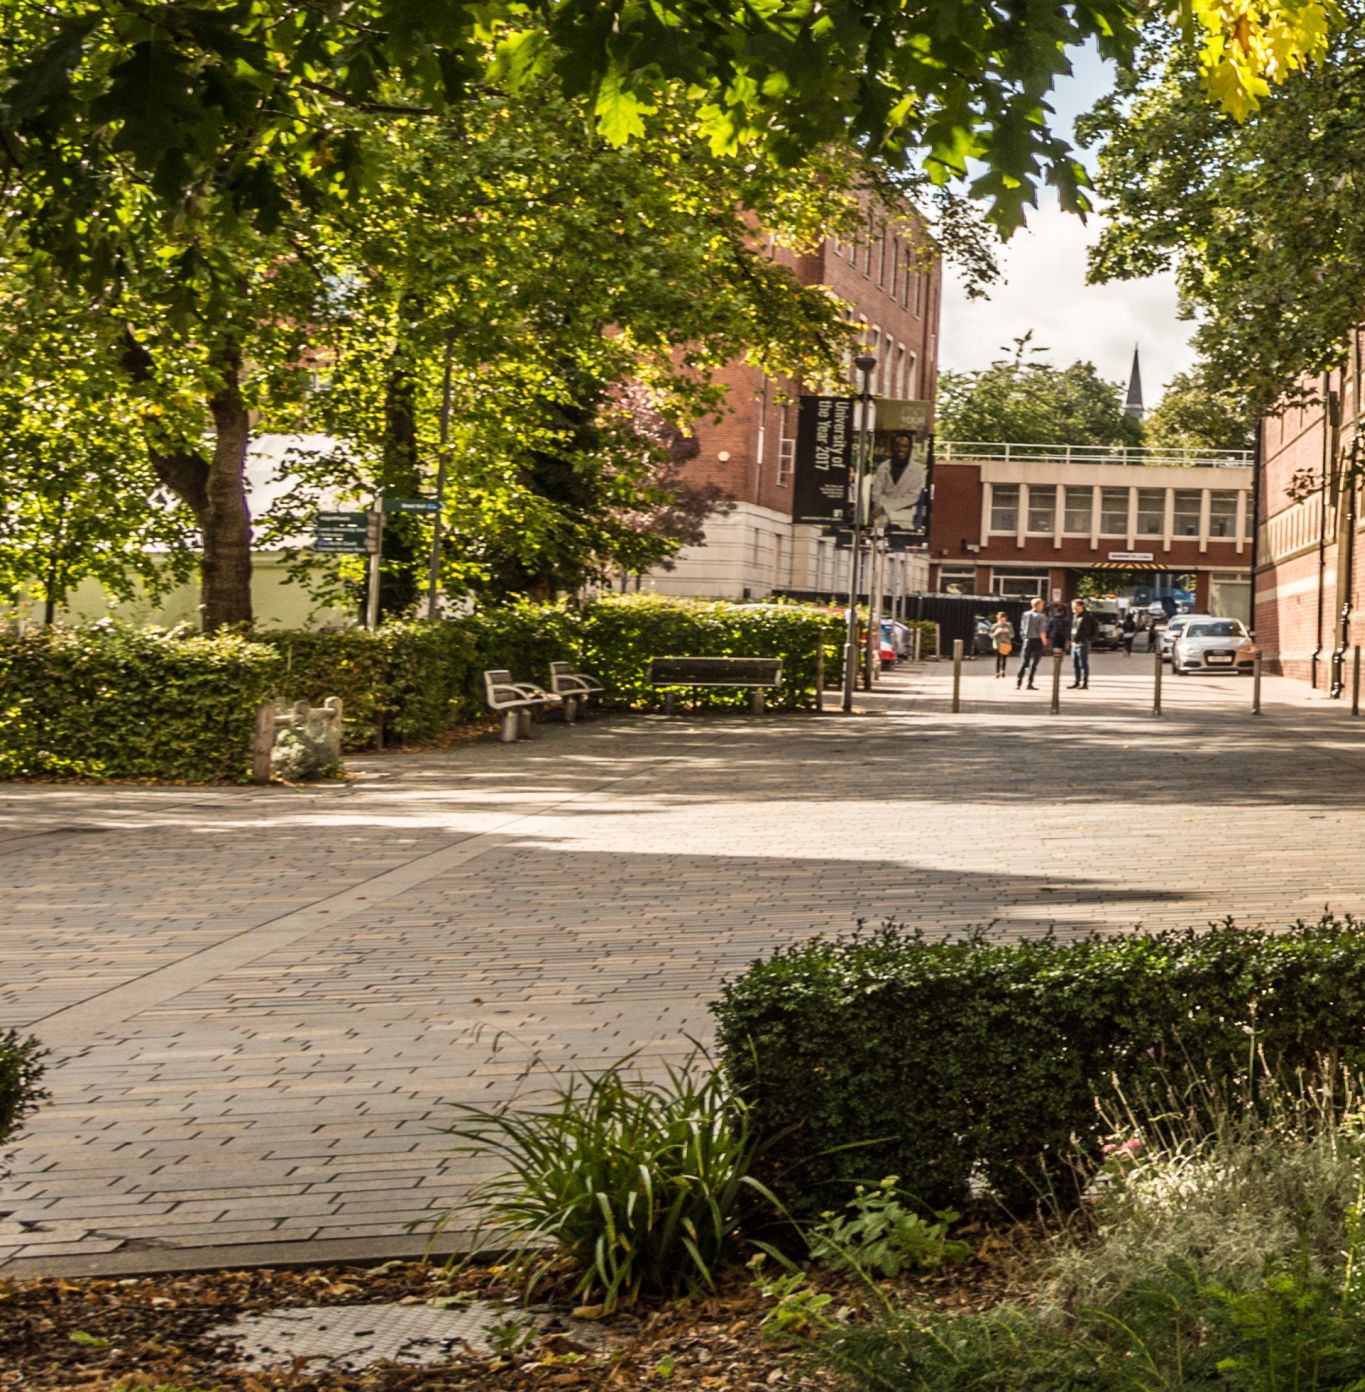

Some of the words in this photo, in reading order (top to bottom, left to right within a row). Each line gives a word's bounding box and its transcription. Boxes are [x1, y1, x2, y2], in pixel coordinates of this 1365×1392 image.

[818, 400, 833, 418] the
[816, 420, 832, 444] Year
[828, 400, 850, 455] University
[814, 446, 830, 471] 2017
[831, 456, 847, 469] of
